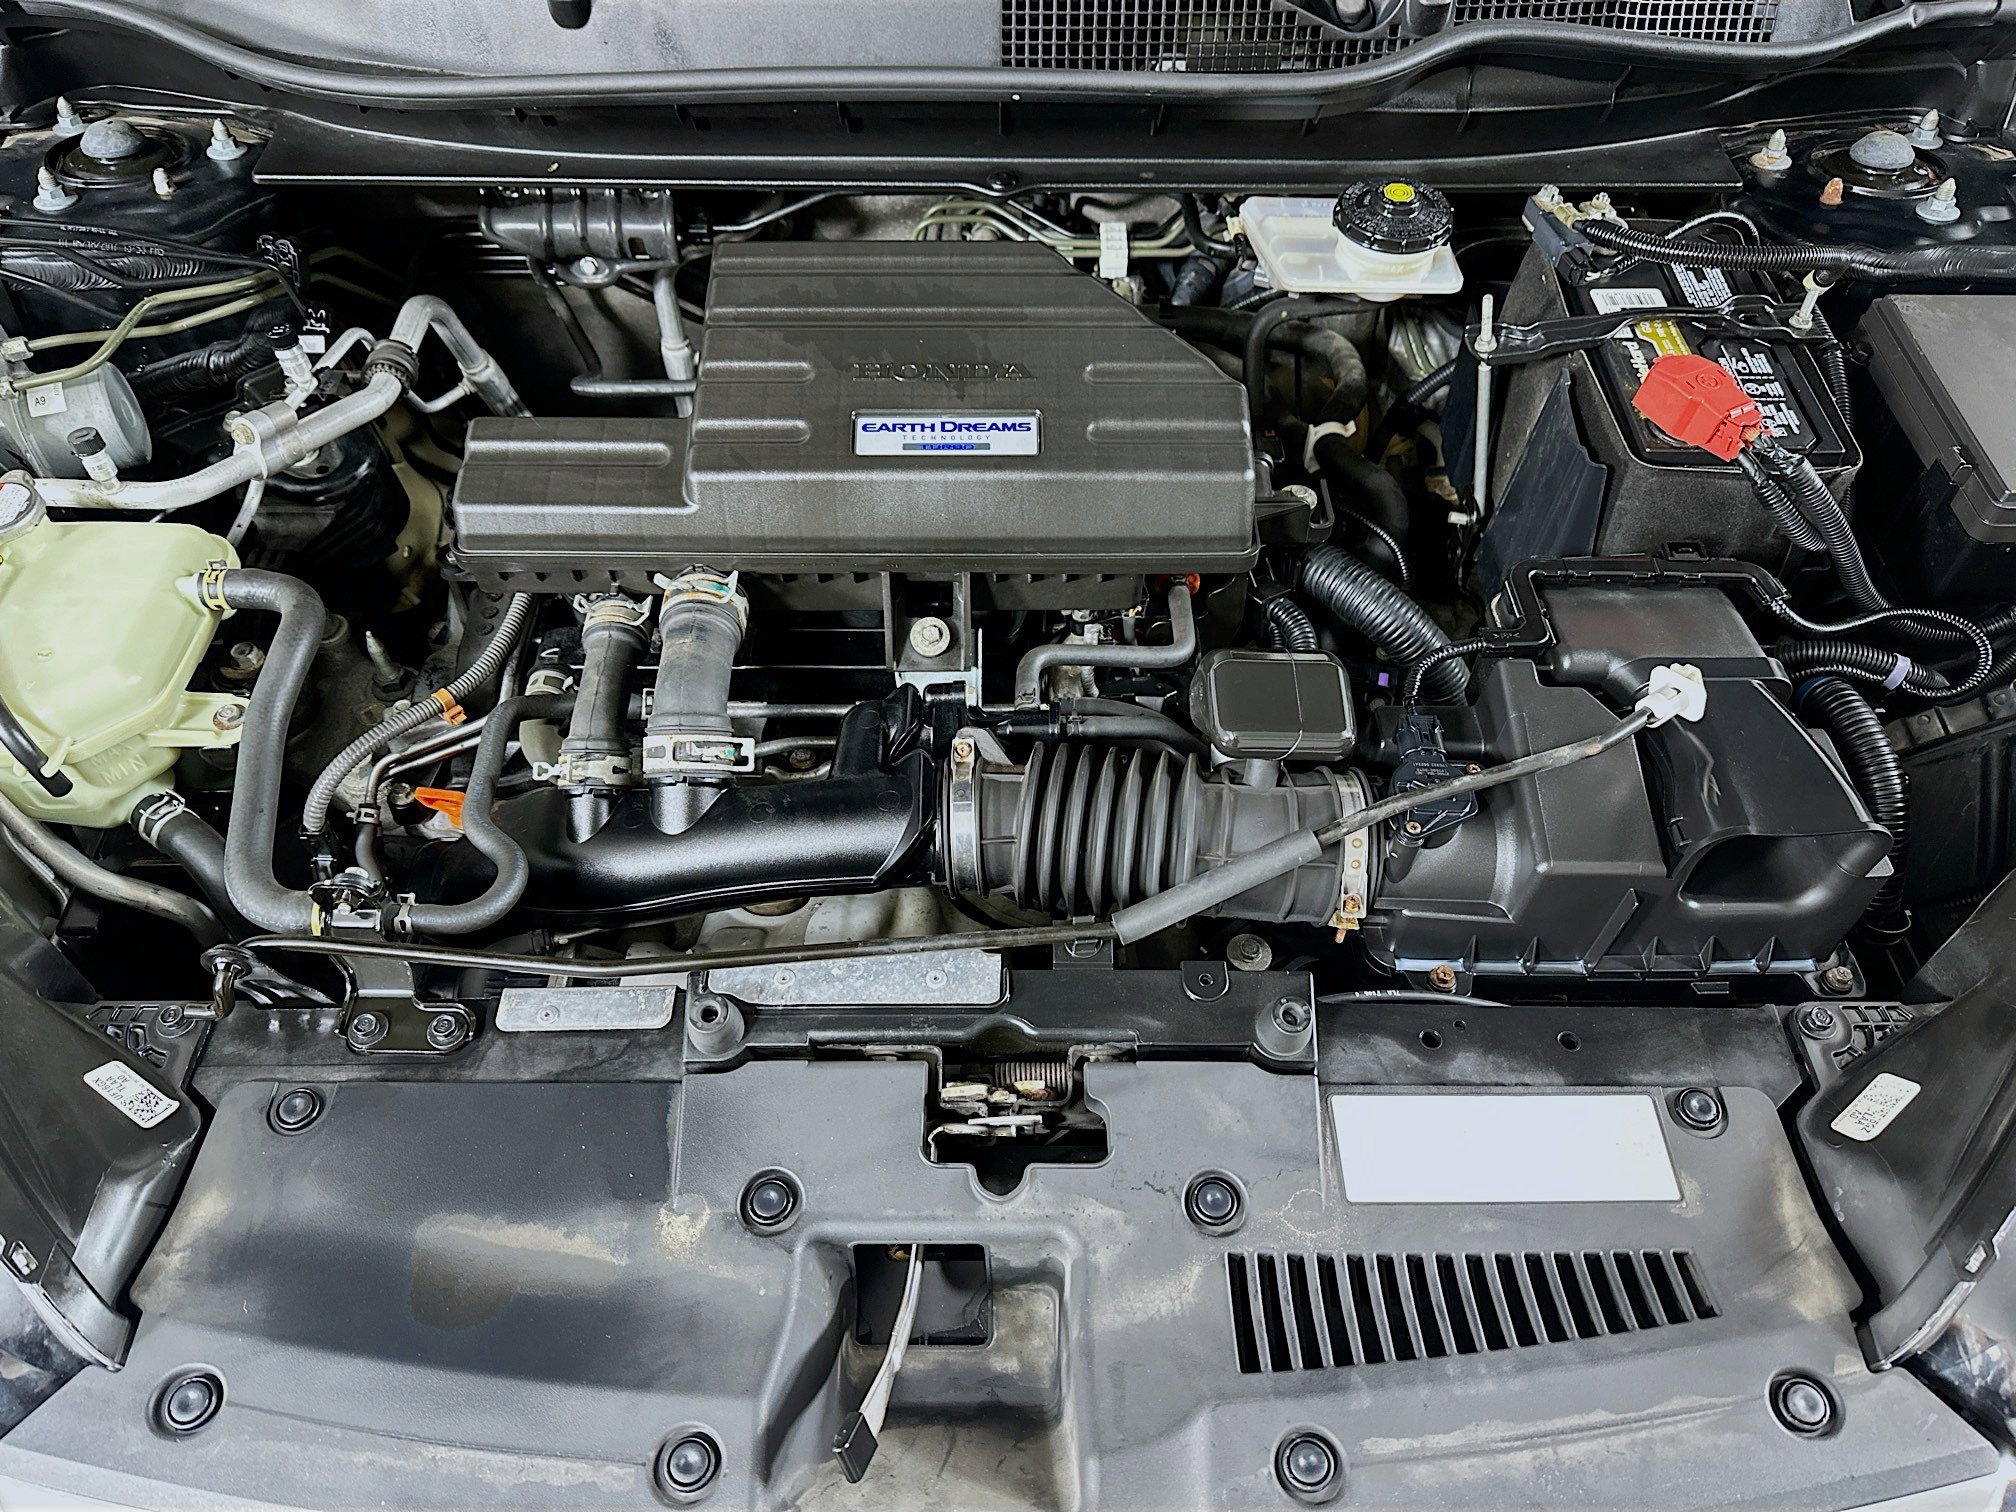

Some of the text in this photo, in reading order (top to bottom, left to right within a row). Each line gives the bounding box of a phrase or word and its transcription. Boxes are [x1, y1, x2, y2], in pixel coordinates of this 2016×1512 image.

[1622, 341, 1650, 384] ieHard
[853, 363, 1037, 381] HONDA
[35, 396, 46, 406] A9
[862, 421, 1032, 433] EARTH DREAMS
[921, 443, 975, 451] TURBO
[101, 753, 147, 784] MIN
[106, 1075, 126, 1092] TLAA
